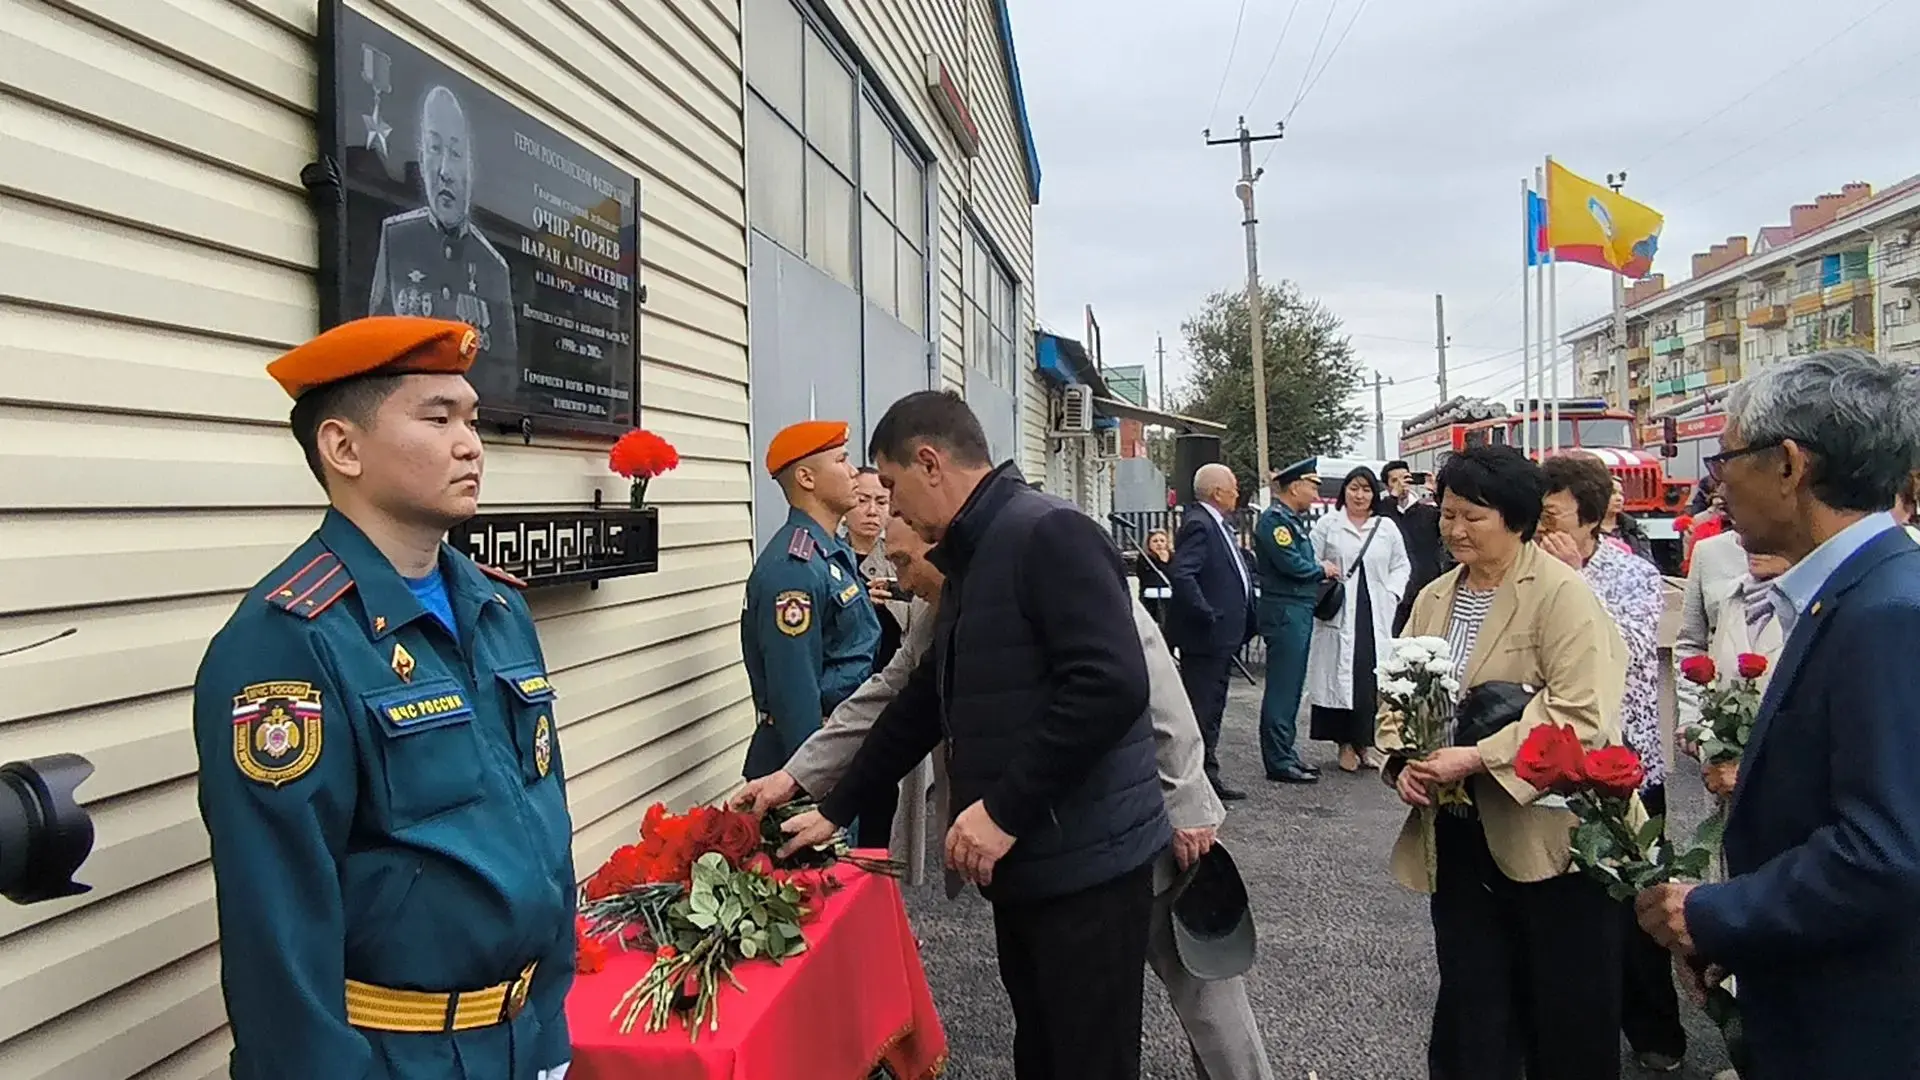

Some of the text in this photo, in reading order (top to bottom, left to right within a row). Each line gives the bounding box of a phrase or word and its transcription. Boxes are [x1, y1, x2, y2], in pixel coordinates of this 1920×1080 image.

[533, 206, 620, 261] ОЧИР-ГОРЯЕВ
[521, 235, 629, 291] НАРАН АЛЕКСЕЕВИЧ
[270, 685, 306, 695] РОССИИ
[388, 695, 464, 721] МЧС РОССИИ
